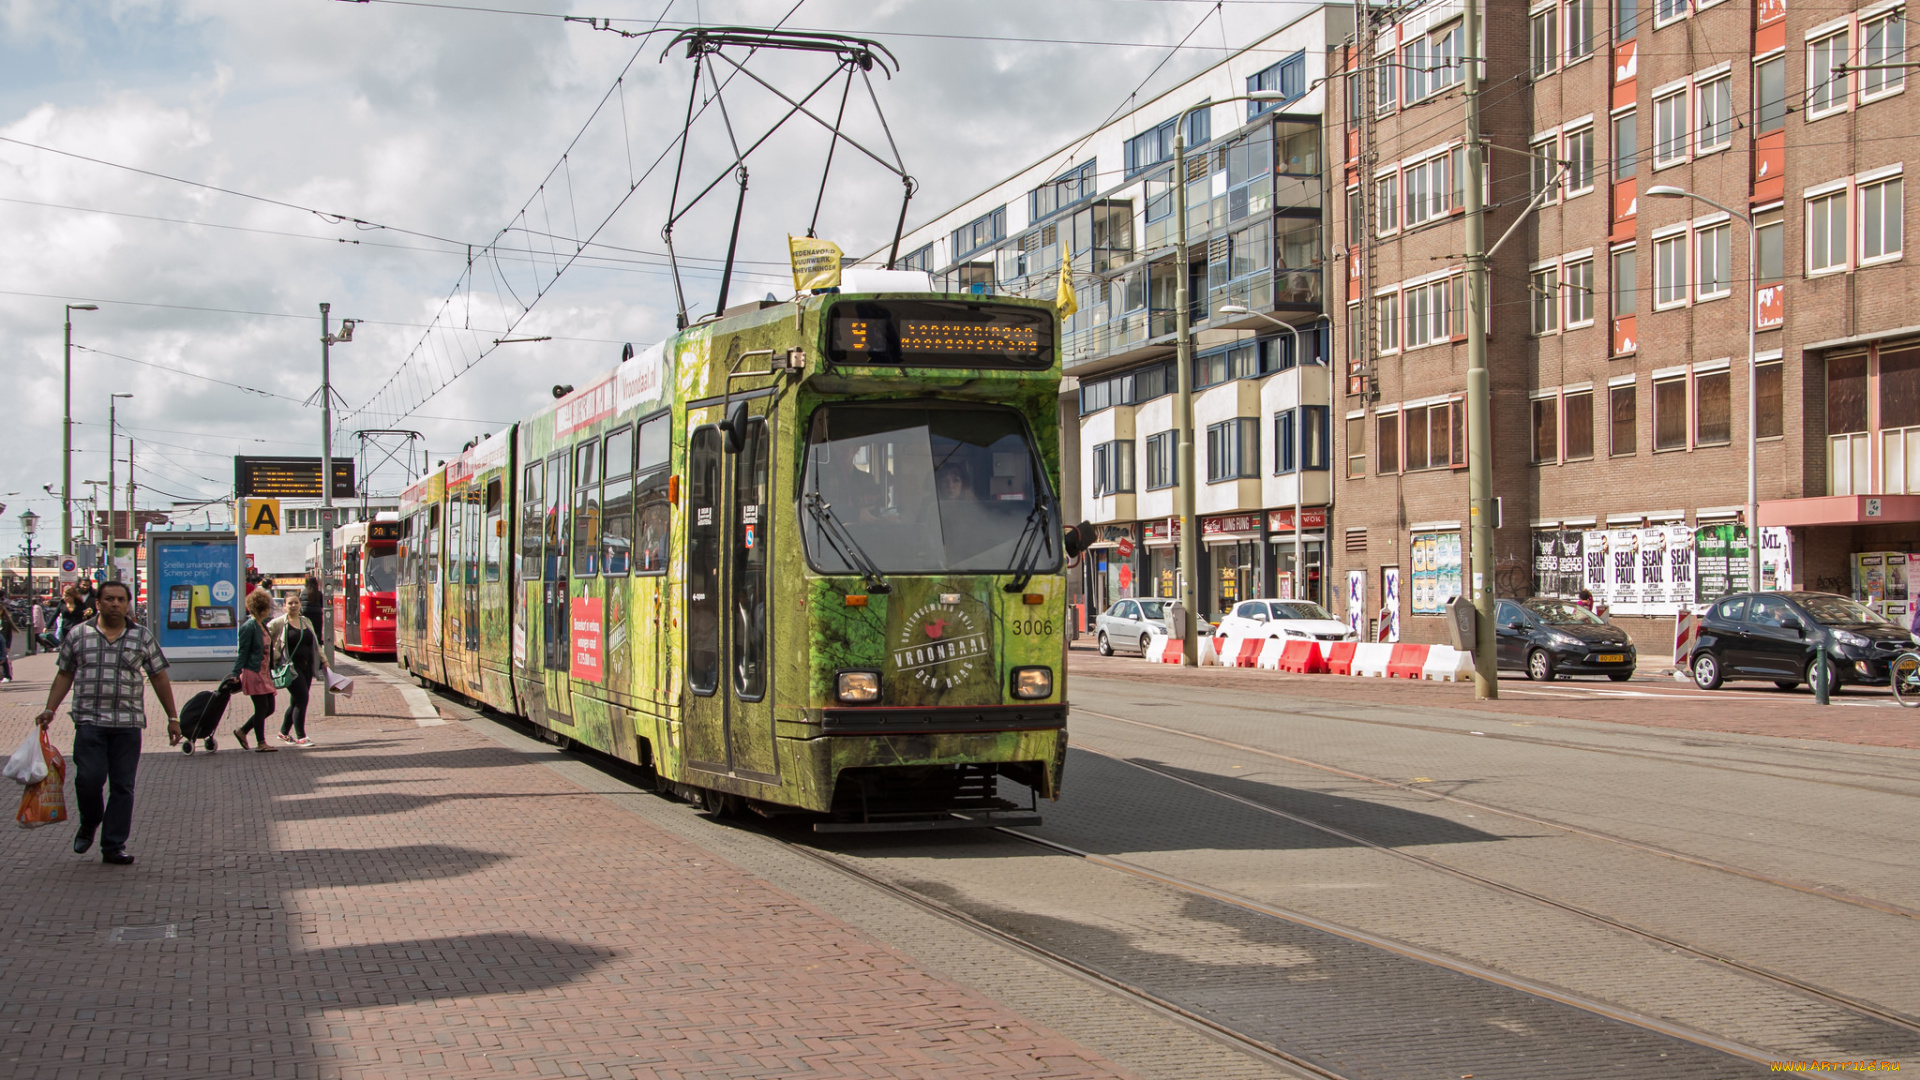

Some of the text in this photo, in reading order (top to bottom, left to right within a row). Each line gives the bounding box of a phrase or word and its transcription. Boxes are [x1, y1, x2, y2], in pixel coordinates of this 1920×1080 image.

[795, 256, 830, 265] VUURWERK
[253, 504, 278, 530] A
[1222, 518, 1235, 531] LUNG
[1236, 516, 1249, 530] FUNG
[1588, 552, 1605, 567] SEAN
[1615, 552, 1635, 567] SEAN
[1642, 550, 1663, 566] SEAN
[1671, 548, 1690, 565] SEAN
[163, 561, 185, 569] Snelle
[164, 569, 193, 577] Scherpe
[1588, 568, 1605, 583] PAUL
[1615, 568, 1636, 583] PAUL
[1642, 566, 1664, 583] PAUL
[1672, 565, 1691, 582] PAUL
[1012, 620, 1053, 636] 3006
[894, 637, 987, 667] VROONDAAL
[915, 661, 973, 689] DEN HAAG
